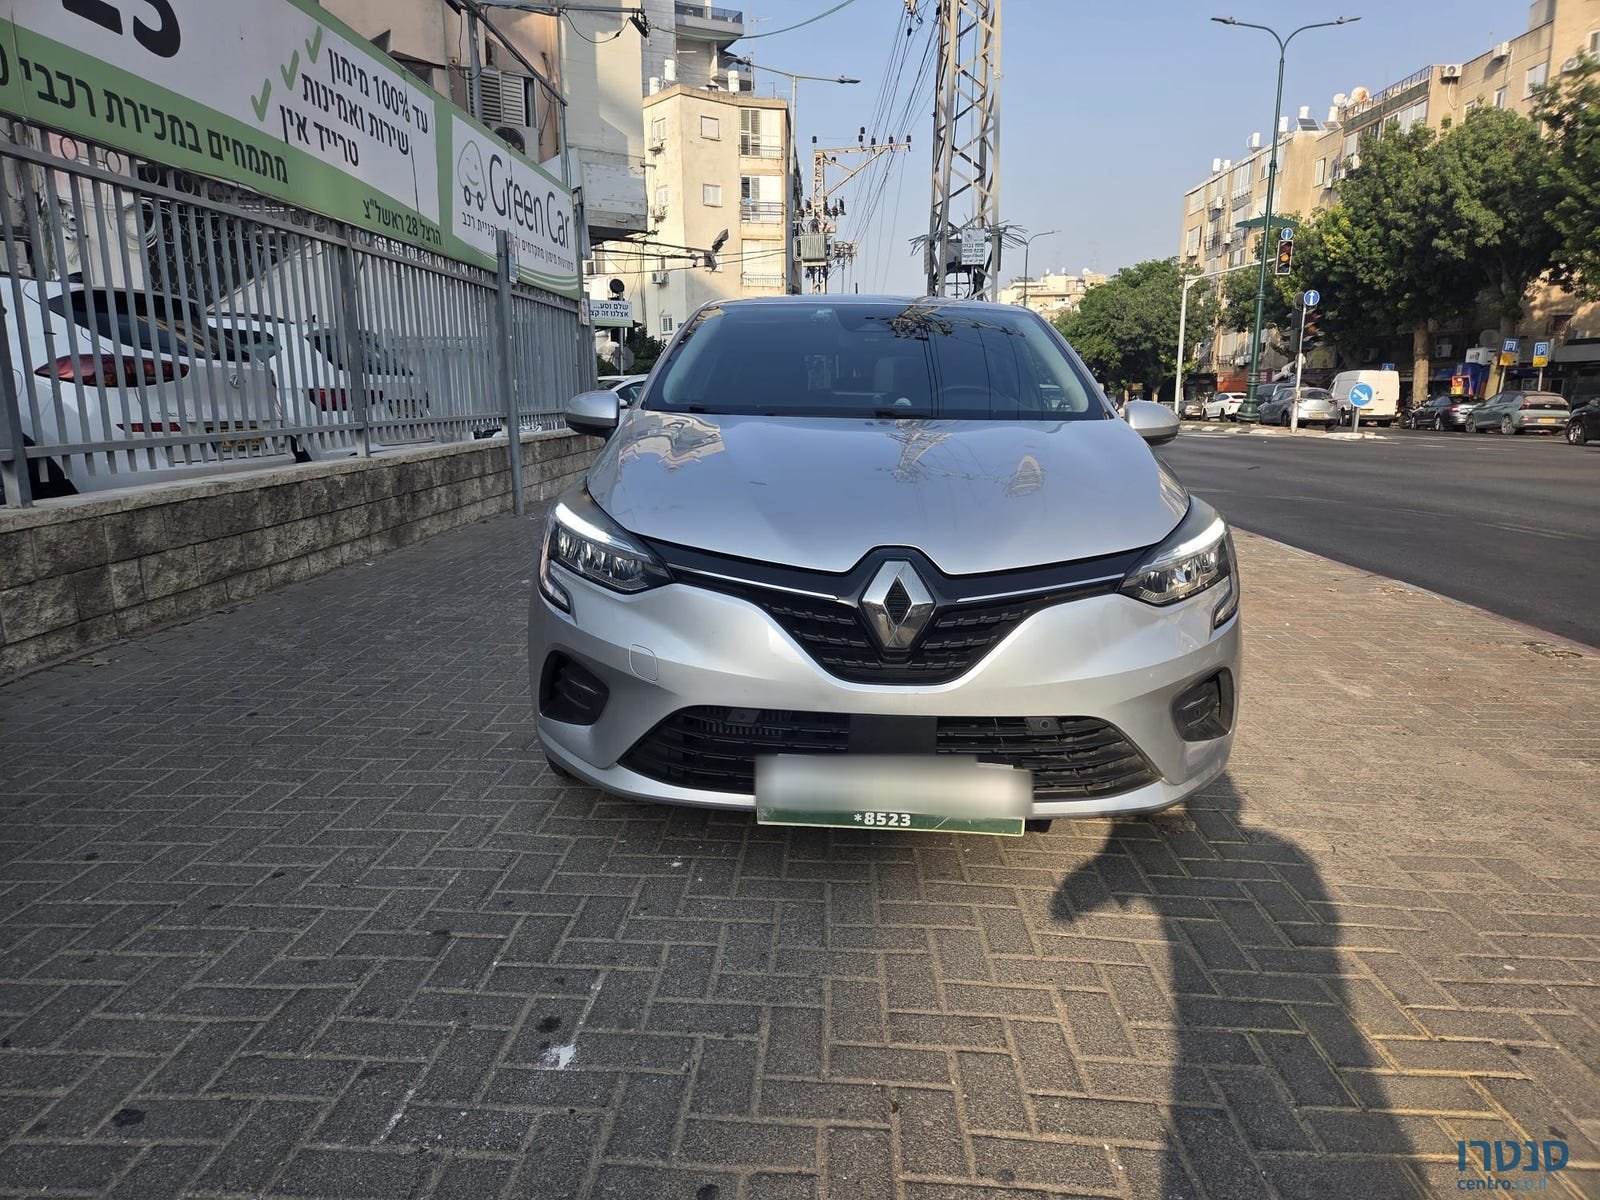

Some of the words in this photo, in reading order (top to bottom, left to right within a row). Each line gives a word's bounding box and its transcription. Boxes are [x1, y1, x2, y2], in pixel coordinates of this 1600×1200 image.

[19, 57, 97, 118] רכבי
[327, 47, 370, 98] מימון
[301, 73, 365, 133] ואמינות
[373, 75, 411, 123] 100%
[412, 104, 428, 134] עד
[103, 88, 203, 155] במכירת
[279, 104, 311, 145] אין
[368, 112, 409, 155] שירות
[207, 129, 289, 185] מתמחים
[313, 121, 360, 167] טרייד
[462, 212, 475, 230] רכב
[489, 153, 545, 237] Green
[546, 191, 570, 249] Car
[405, 214, 418, 237] 28
[420, 218, 442, 246] הרצל
[610, 310, 629, 318] אצלנו
[613, 302, 629, 310] שלם
